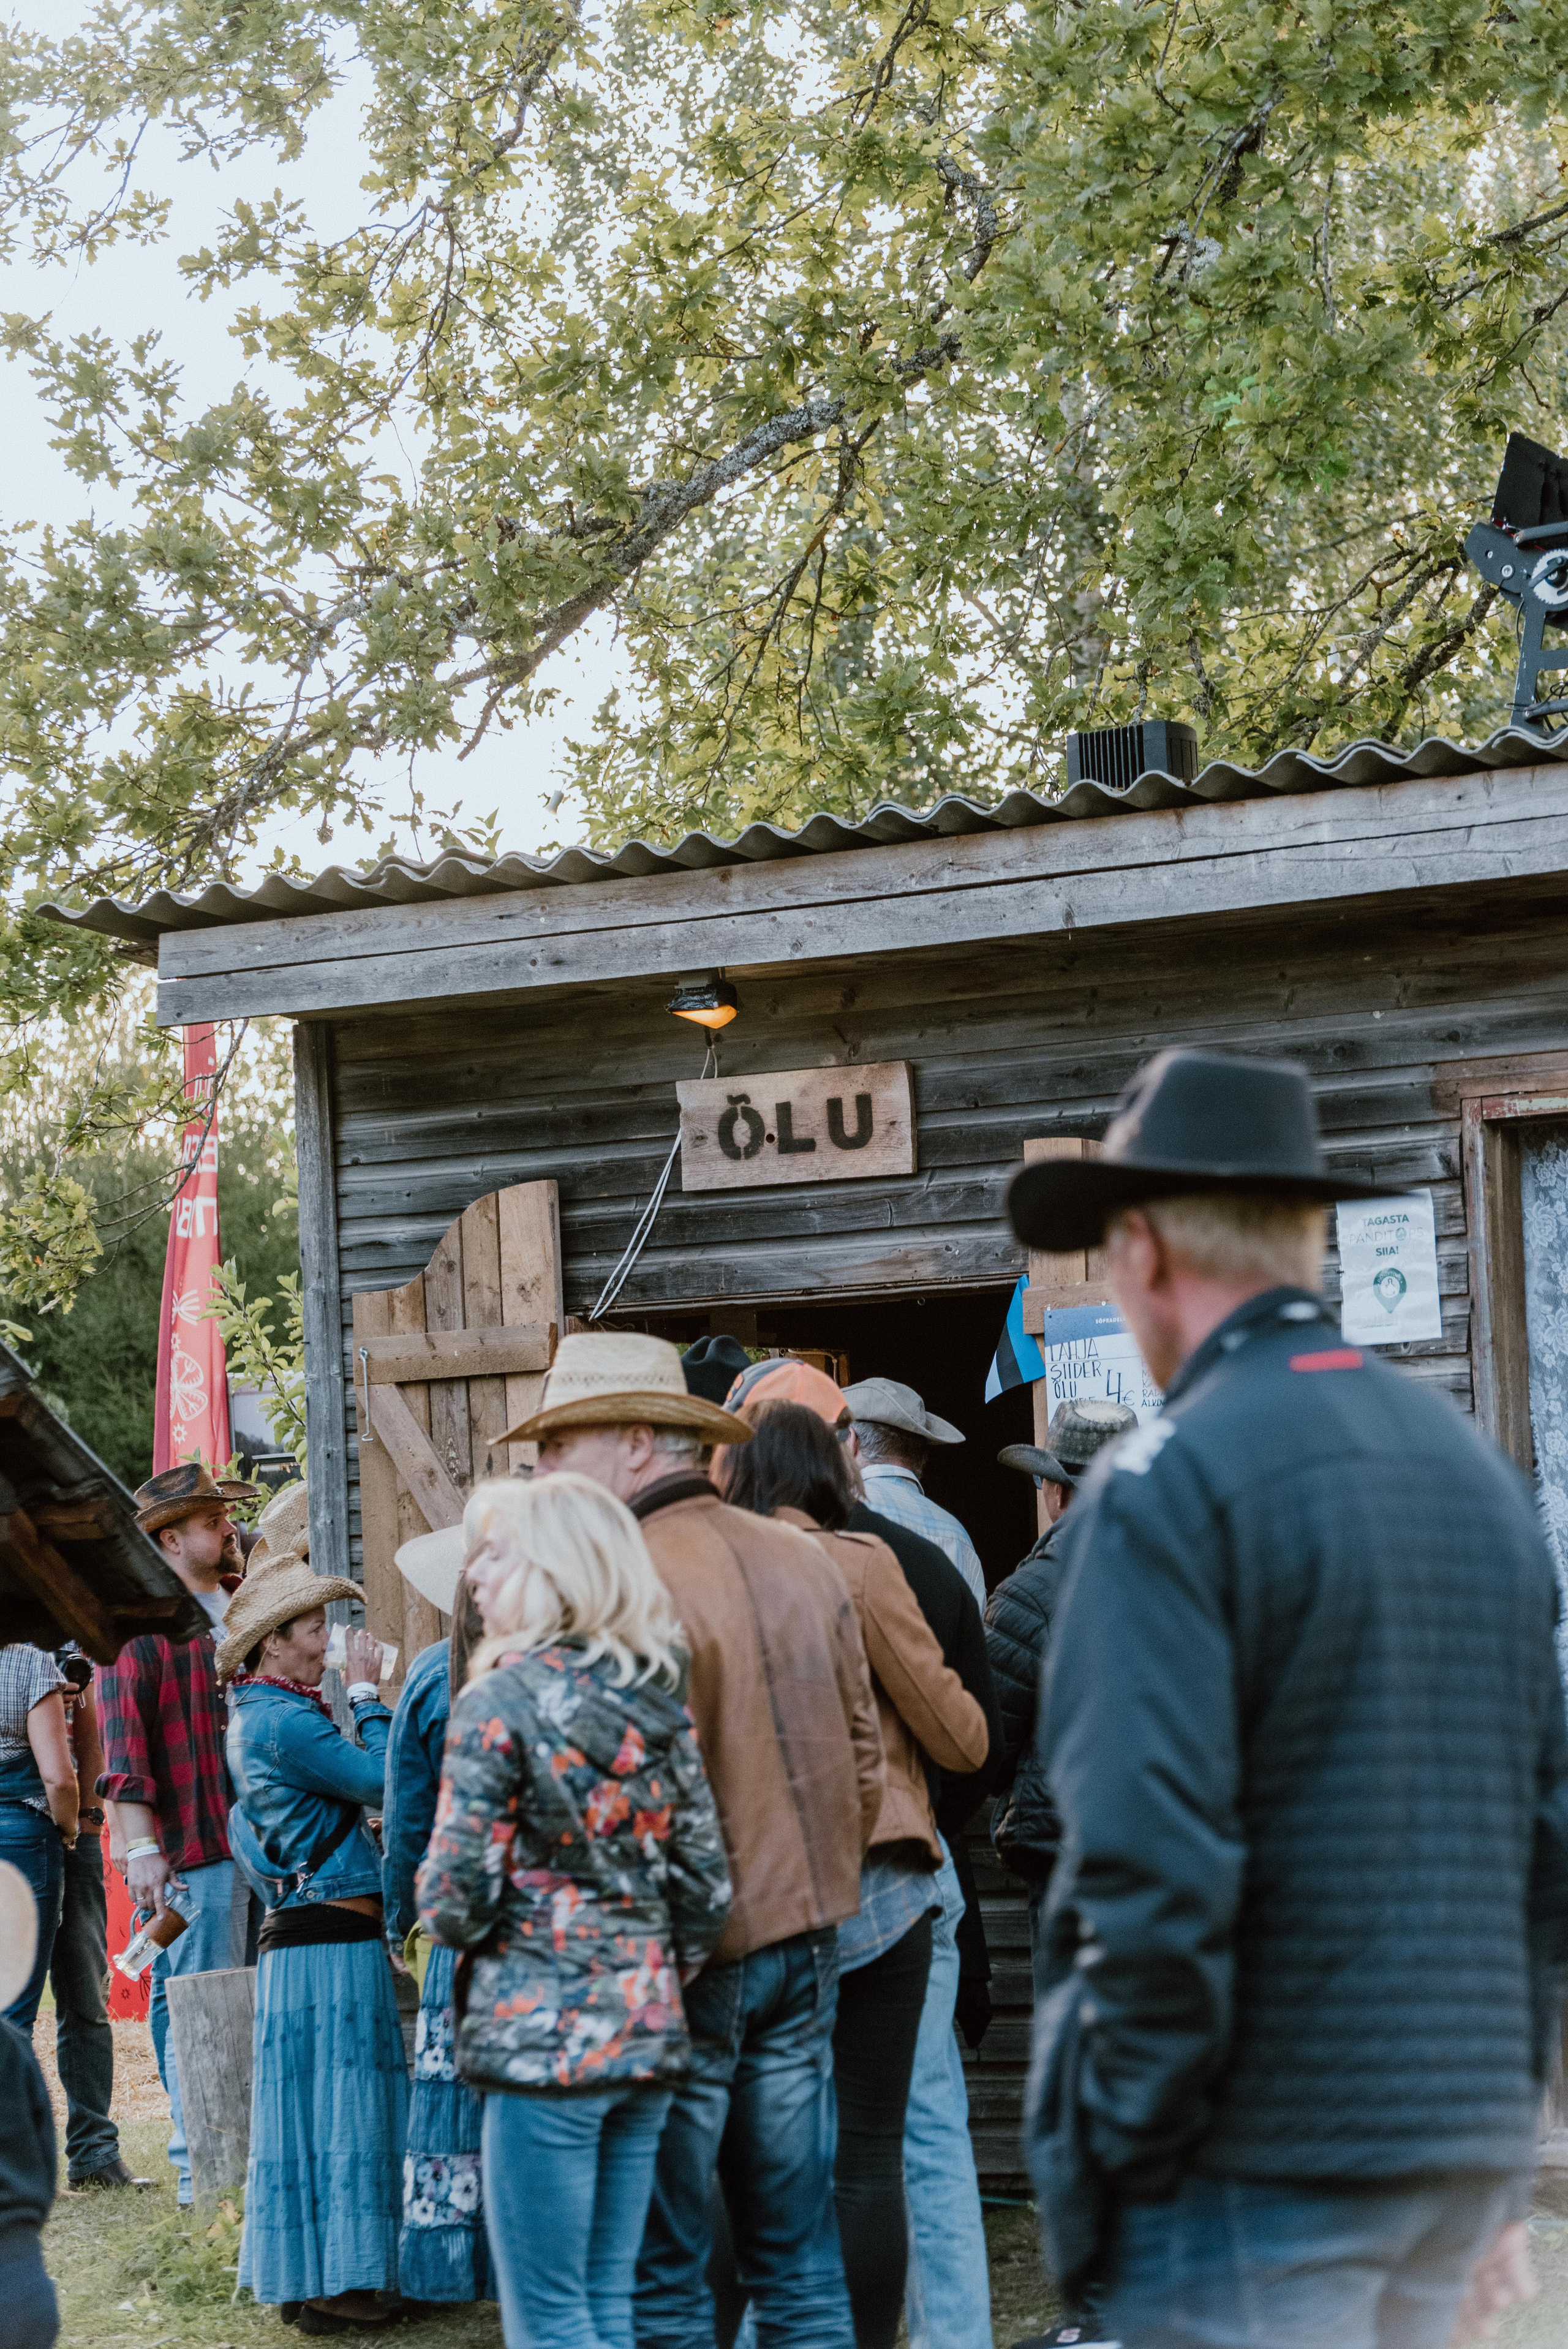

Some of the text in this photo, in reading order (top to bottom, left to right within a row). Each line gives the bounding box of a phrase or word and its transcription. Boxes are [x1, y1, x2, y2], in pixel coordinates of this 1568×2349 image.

[718, 1093, 873, 1160] ÕLU
[1363, 1214, 1409, 1227] TAGASTA
[1376, 1246, 1399, 1256] SIIA!
[1050, 1360, 1102, 1380] SIIDER
[1052, 1379, 1077, 1399] ÕLU
